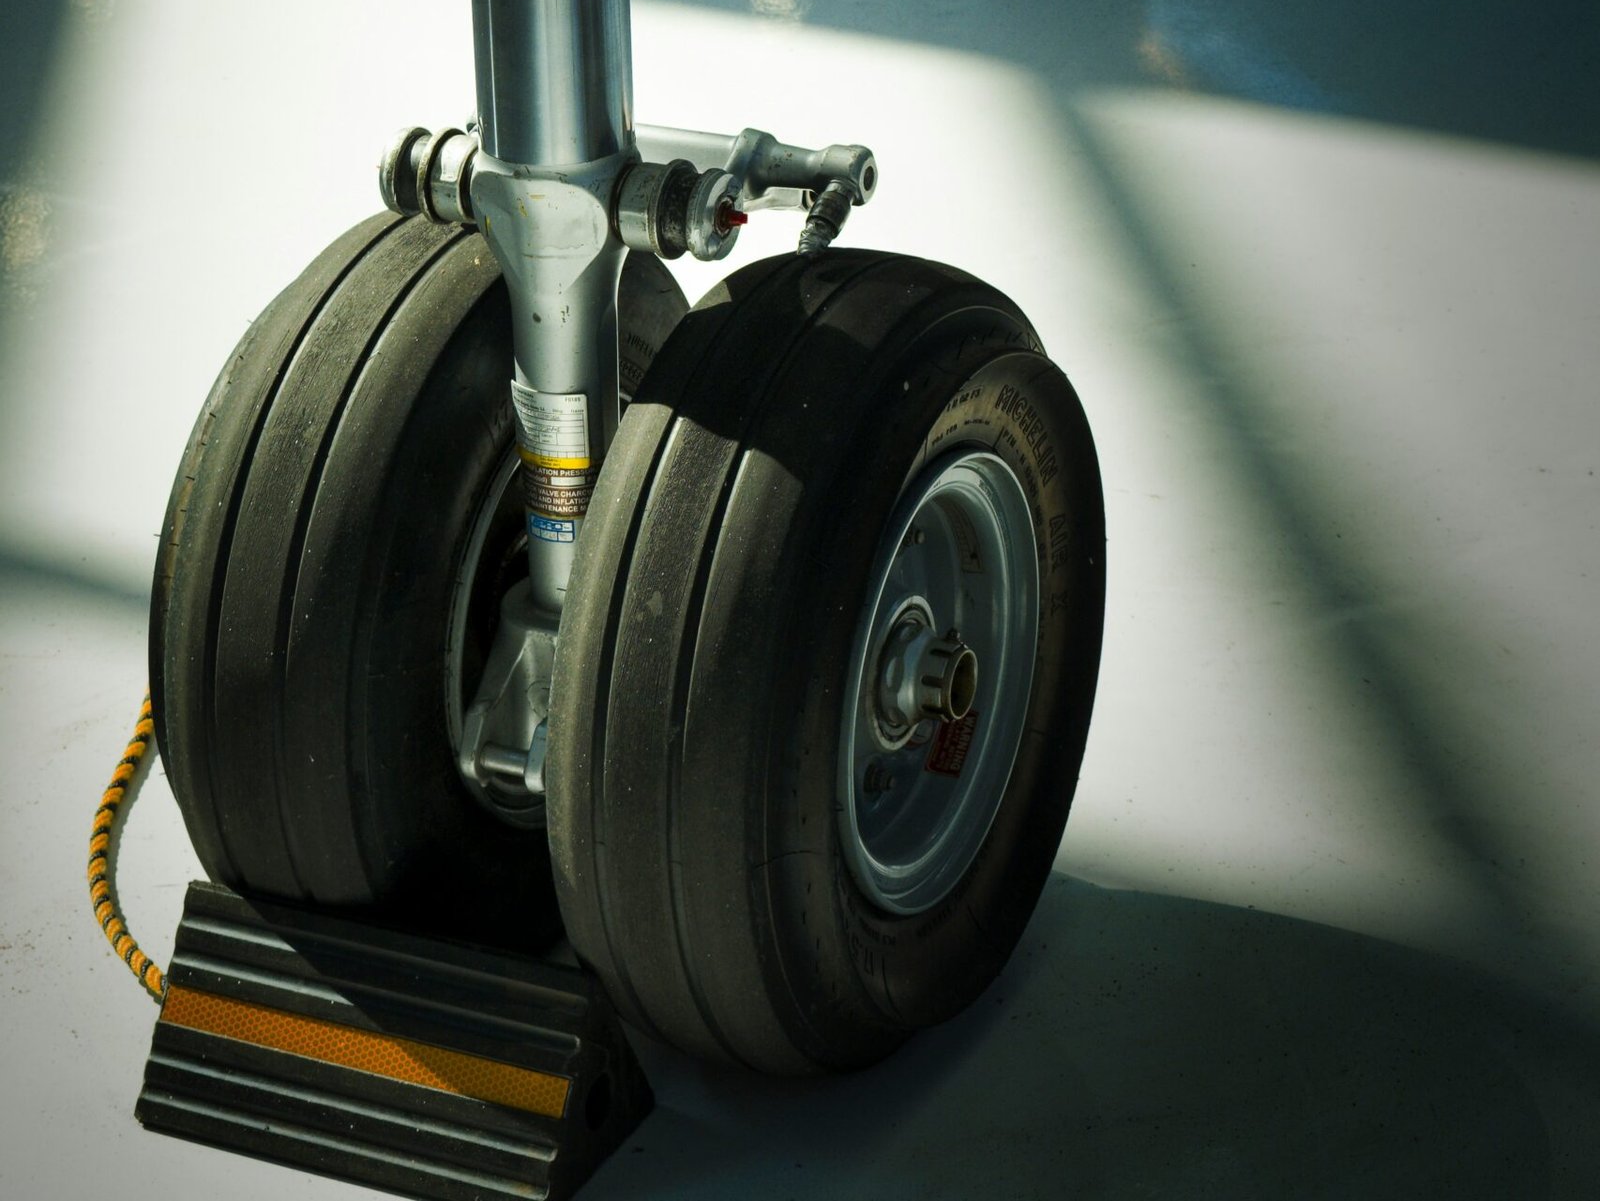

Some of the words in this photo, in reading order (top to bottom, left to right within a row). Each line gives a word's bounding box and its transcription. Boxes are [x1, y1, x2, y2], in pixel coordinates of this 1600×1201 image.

[995, 384, 1058, 488] MICHELIN
[539, 487, 559, 498] VALVE
[1049, 512, 1068, 574] AIR
[1051, 590, 1068, 617] X
[949, 715, 978, 771] WARNING
